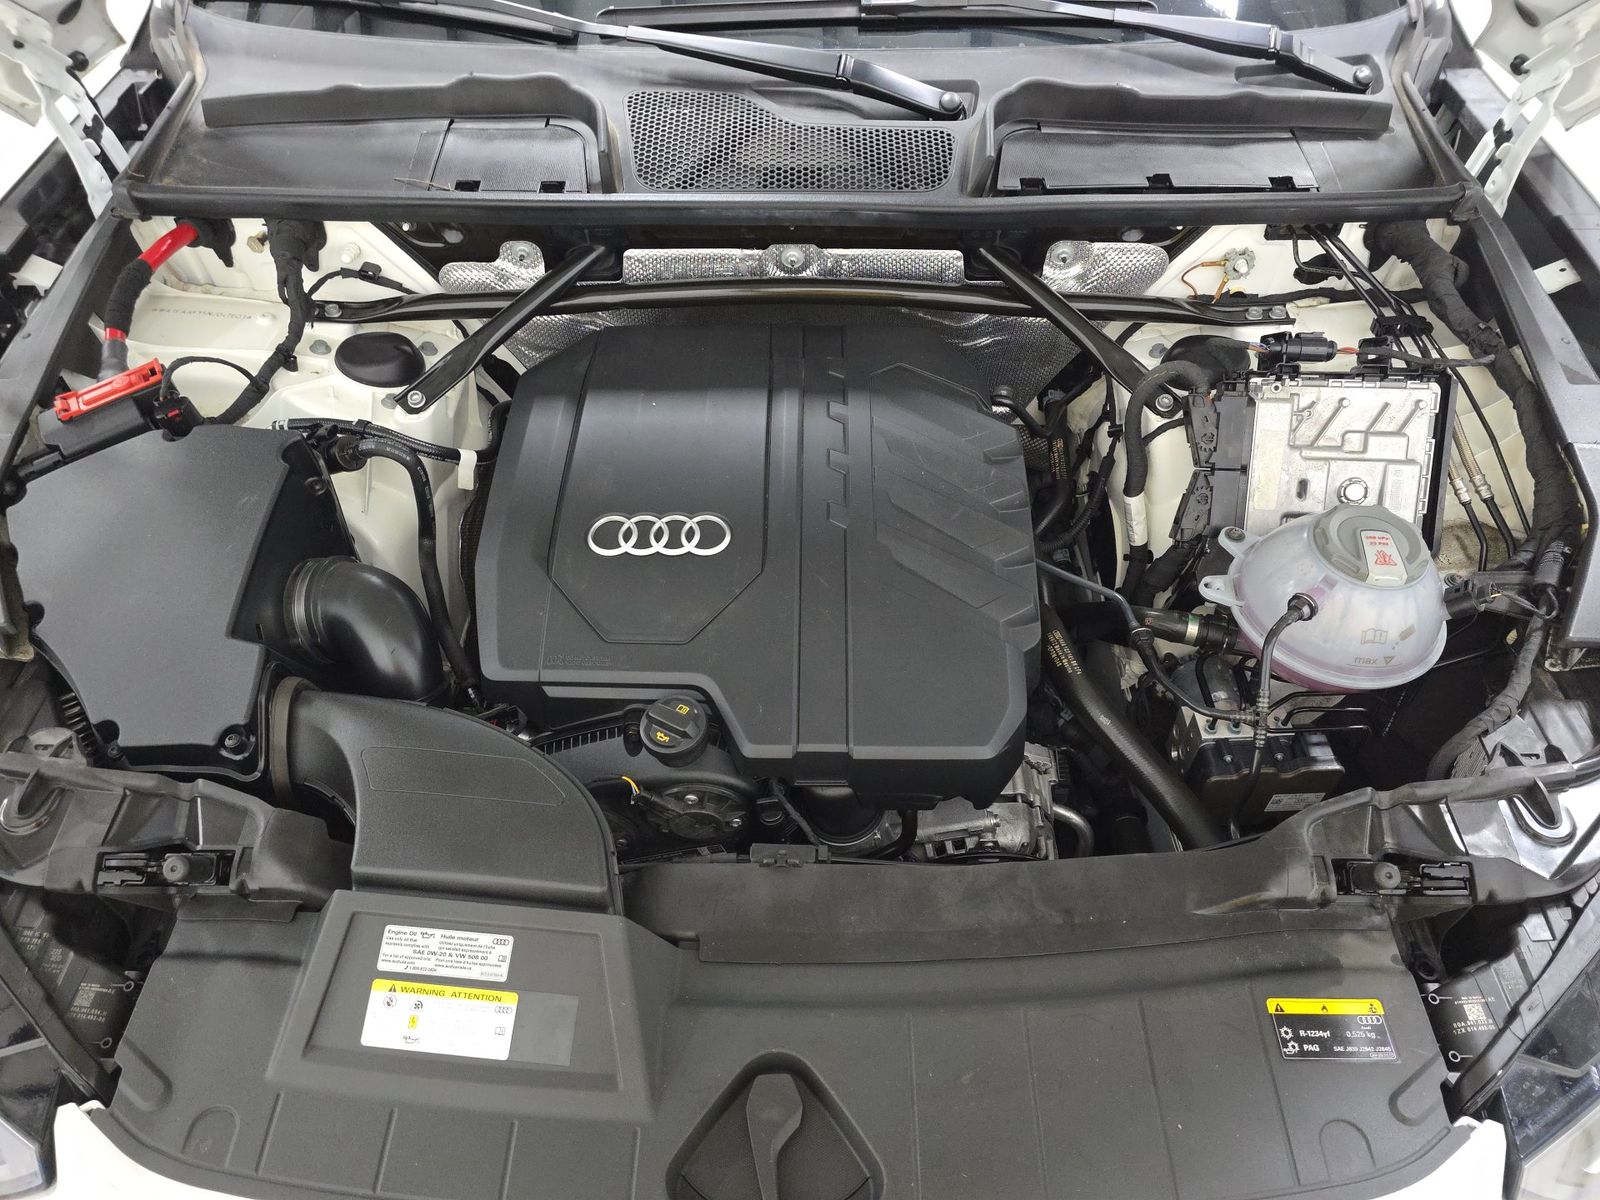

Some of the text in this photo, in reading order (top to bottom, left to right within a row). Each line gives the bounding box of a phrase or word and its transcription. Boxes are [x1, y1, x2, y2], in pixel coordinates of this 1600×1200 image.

[1354, 656, 1377, 665] max
[400, 986, 503, 1002] WARNING ATTENTION
[1299, 1030, 1330, 1039] R-1234yf
